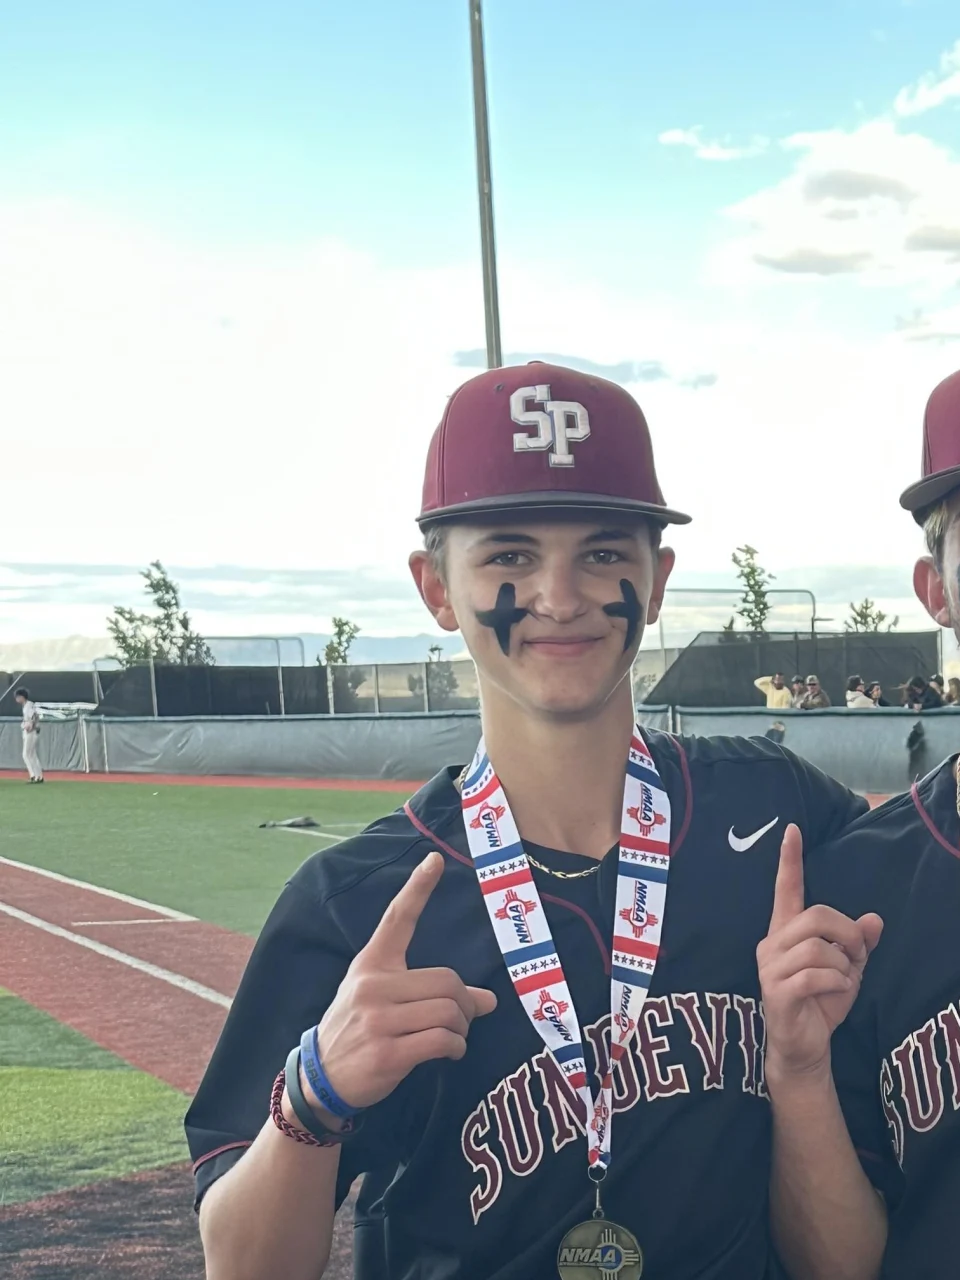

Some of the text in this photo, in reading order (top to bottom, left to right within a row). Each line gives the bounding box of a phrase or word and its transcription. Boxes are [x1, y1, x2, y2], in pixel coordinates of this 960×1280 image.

[510, 384, 591, 467] SP
[481, 812, 501, 848] NMAA
[634, 880, 648, 924] NMAA
[508, 904, 531, 944] NMAA
[560, 1248, 616, 1263] NMAA
